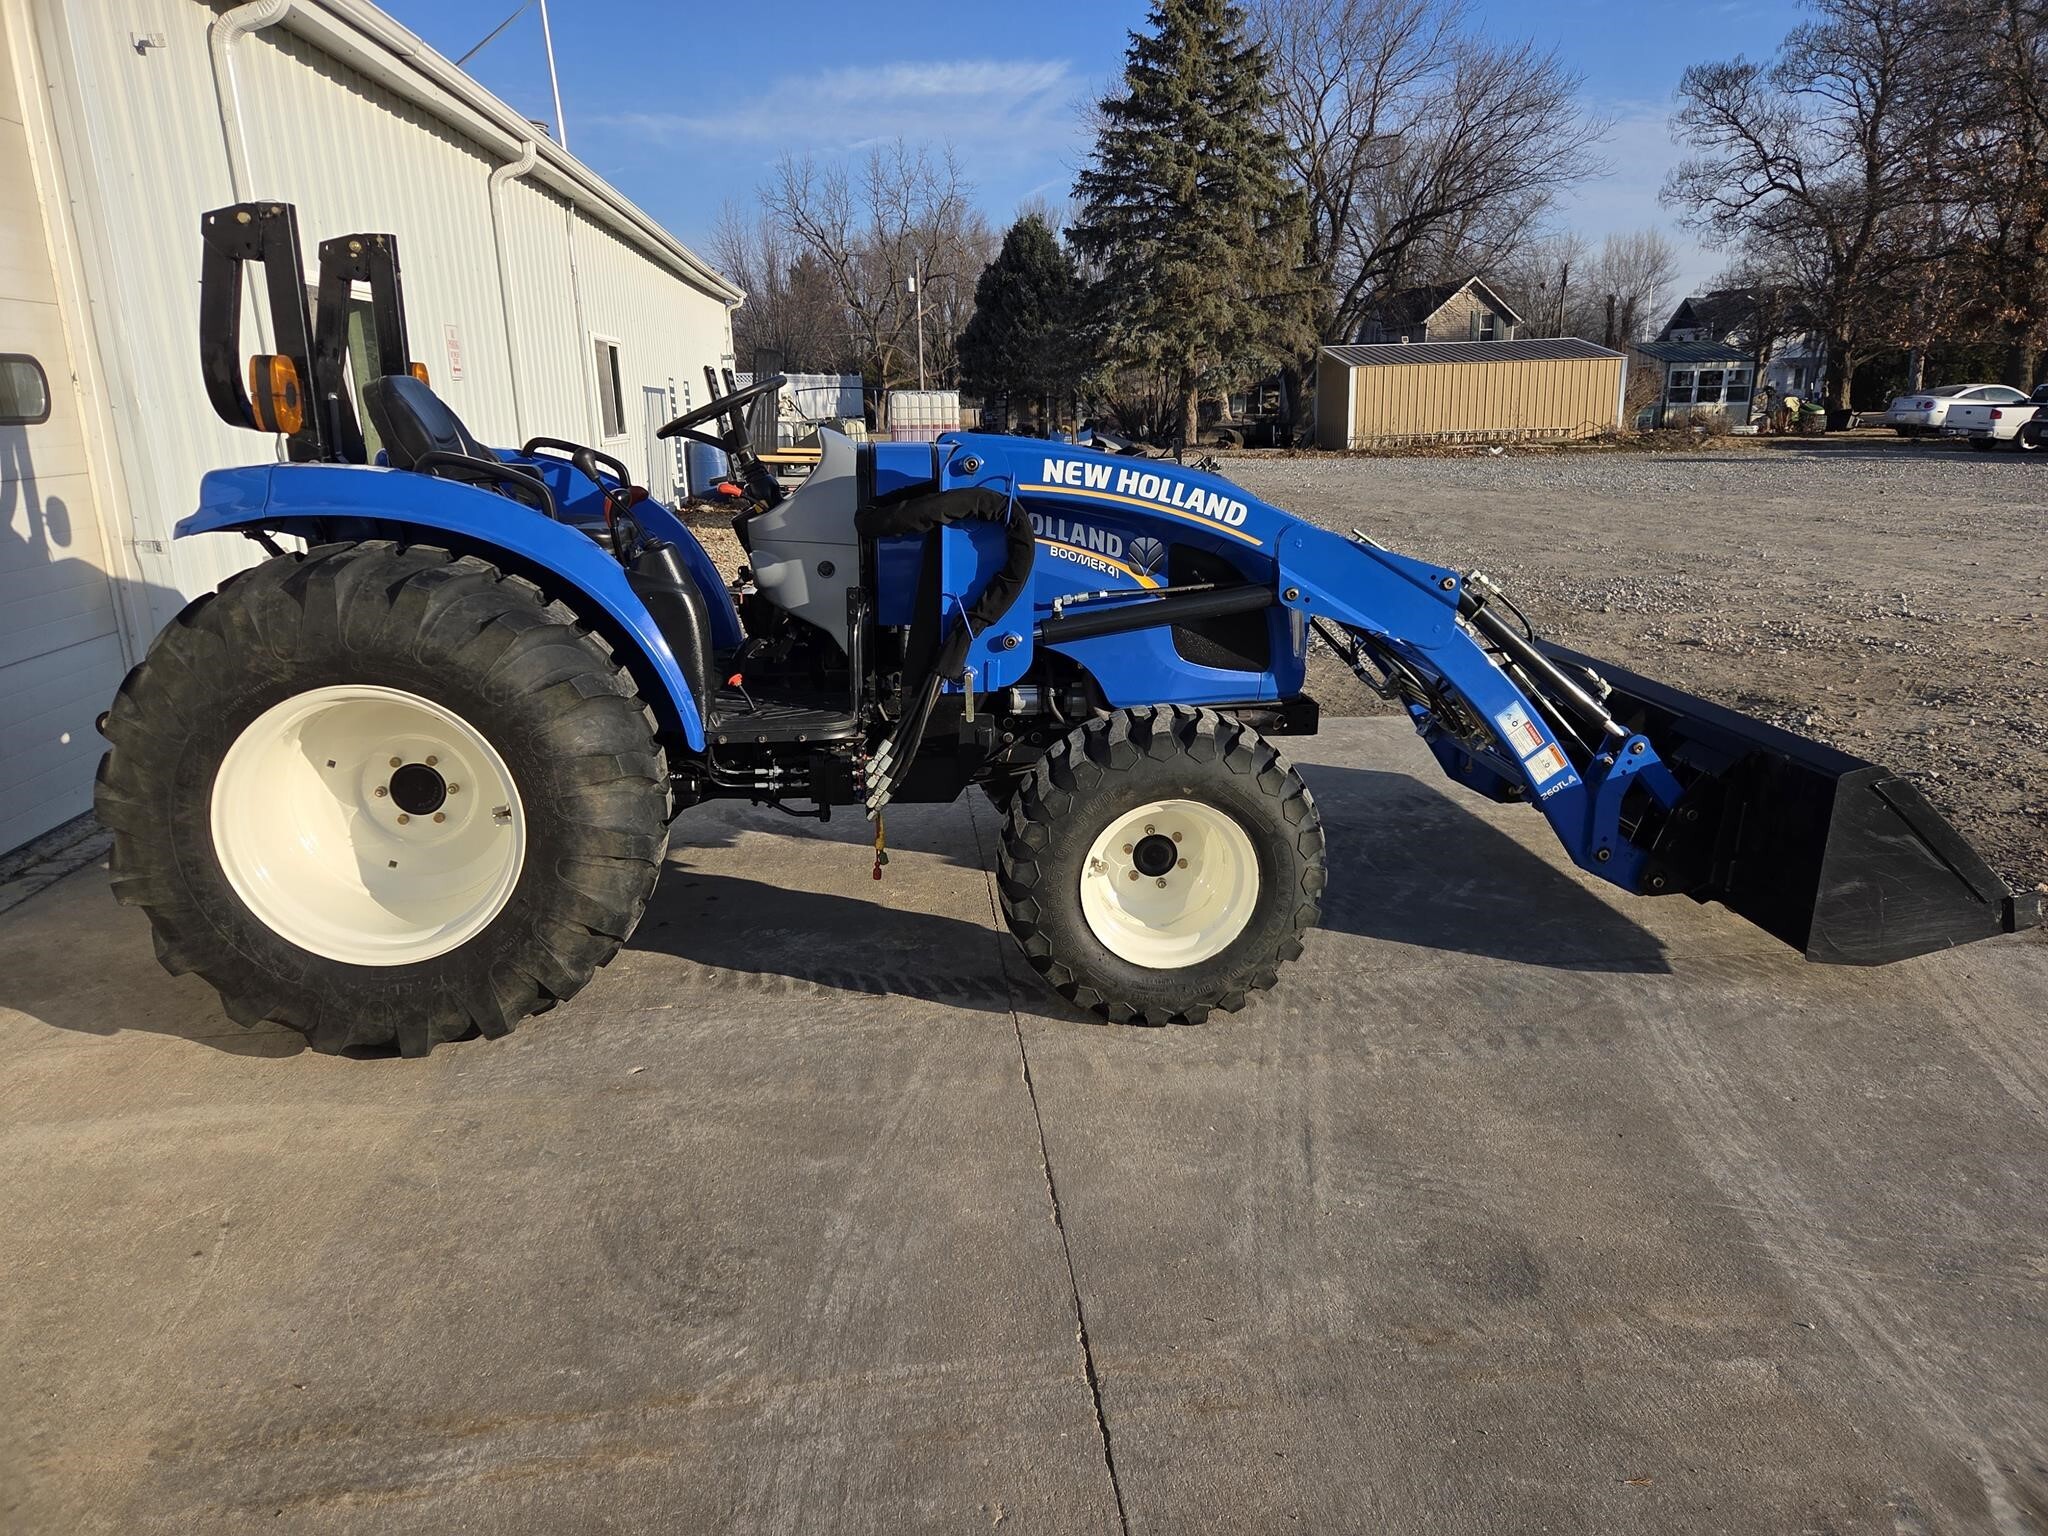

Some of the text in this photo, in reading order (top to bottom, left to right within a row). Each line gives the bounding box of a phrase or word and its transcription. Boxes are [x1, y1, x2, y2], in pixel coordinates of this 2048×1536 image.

[1043, 459, 1248, 526] NEW HOLLAND
[1028, 513, 1123, 558] OLLAND
[1050, 547, 1107, 572] BOOMER
